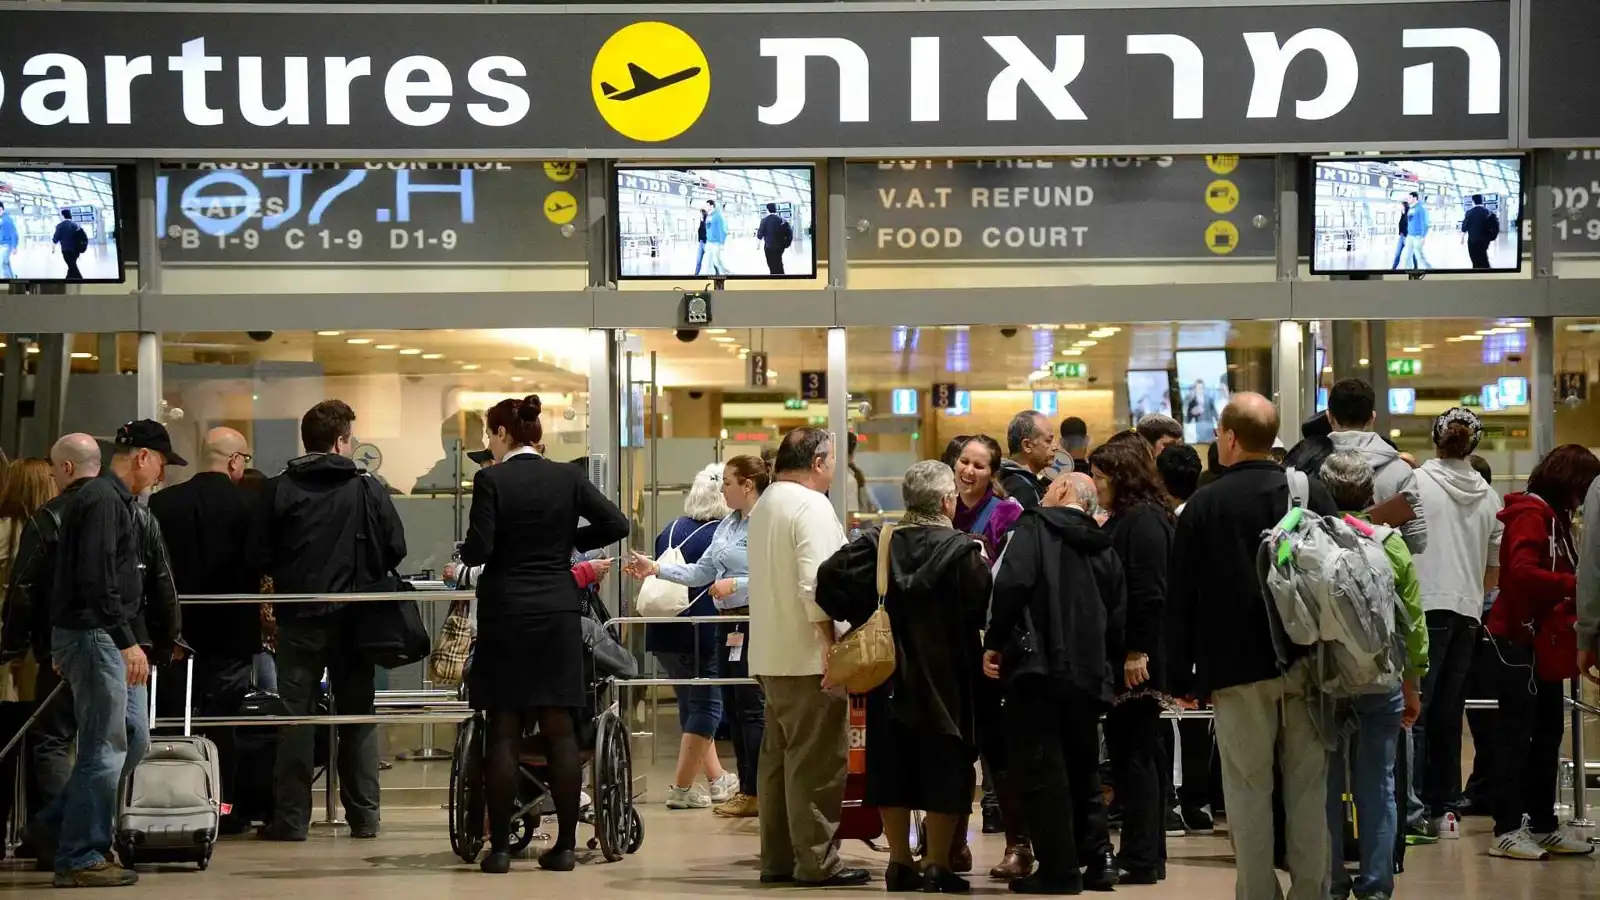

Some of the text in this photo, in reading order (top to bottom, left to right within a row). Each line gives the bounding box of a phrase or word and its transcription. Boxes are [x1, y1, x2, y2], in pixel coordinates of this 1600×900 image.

[0, 37, 530, 126] artures
[758, 28, 1500, 126] המראות
[878, 186, 1094, 208] V.A.T REFUND
[182, 229, 200, 249] B
[217, 229, 259, 249] 1-9
[285, 228, 305, 249] C
[318, 229, 363, 249] 1-9
[878, 226, 1089, 248] FOOD COURT
